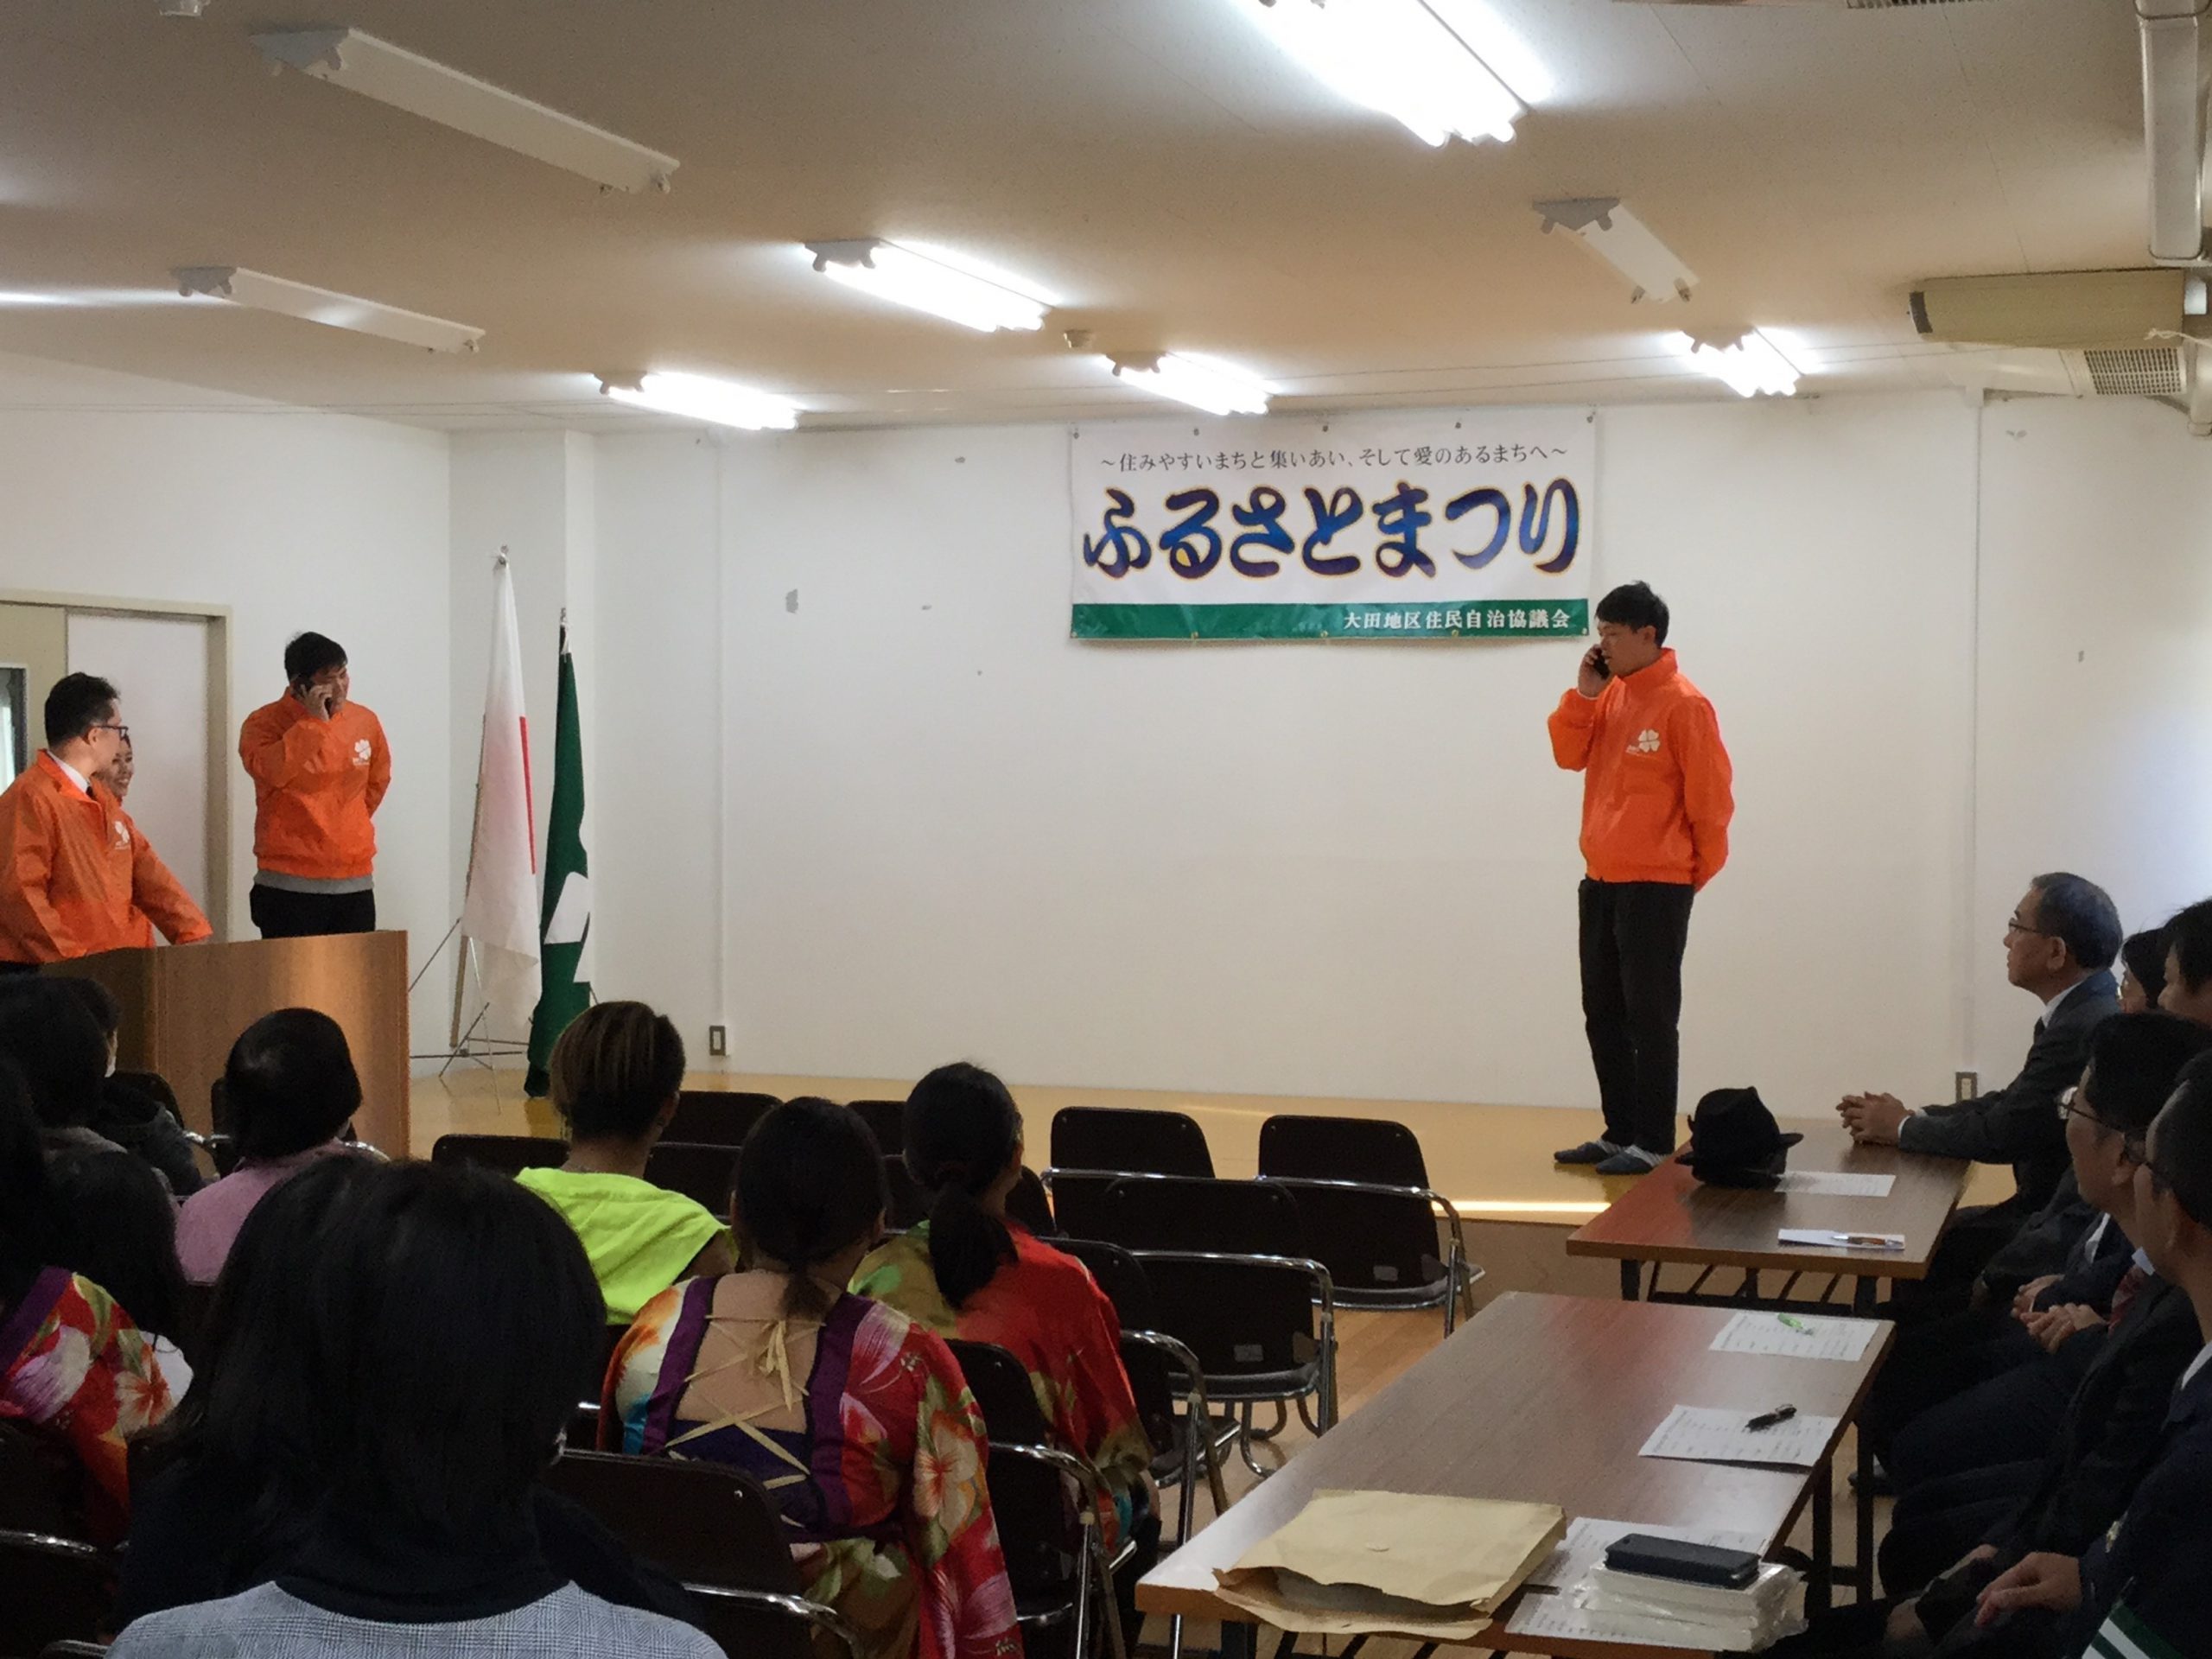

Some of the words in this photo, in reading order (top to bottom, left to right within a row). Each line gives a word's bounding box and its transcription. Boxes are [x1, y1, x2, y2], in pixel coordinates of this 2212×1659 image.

[1082, 477, 1580, 580] ふるさとまつり
[1344, 608, 1571, 630] 大田地区住民自治協議会
